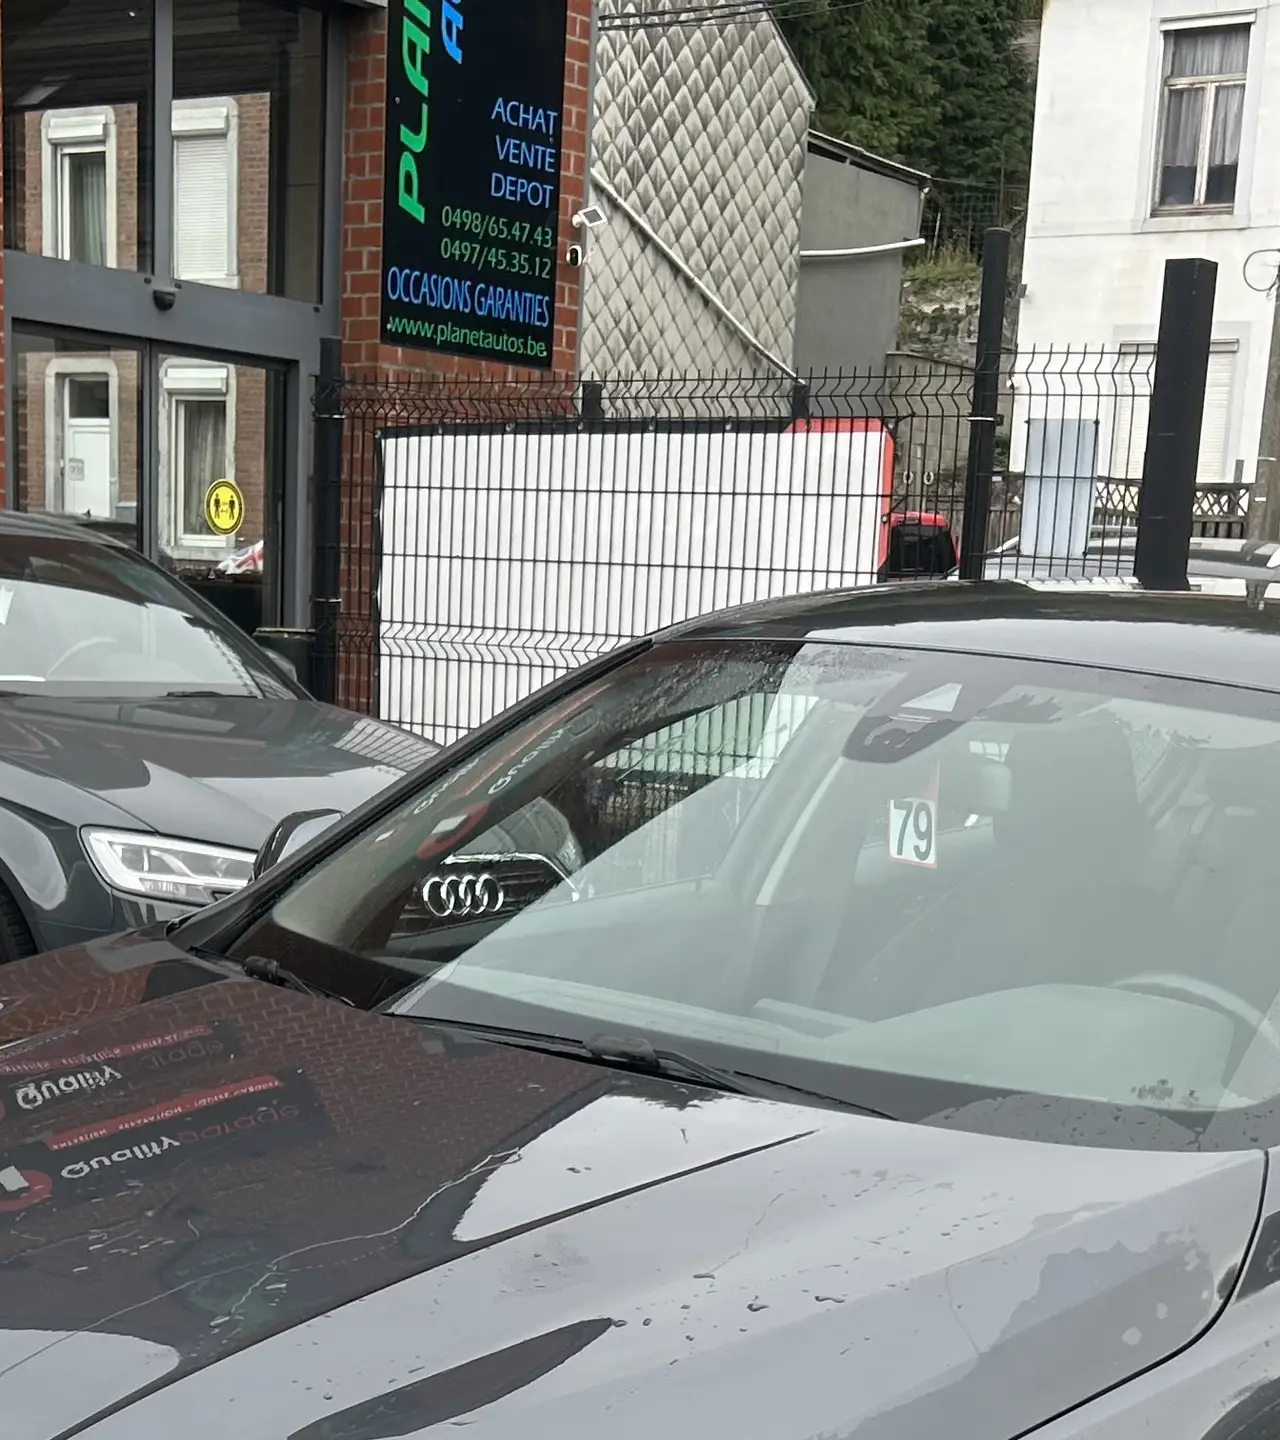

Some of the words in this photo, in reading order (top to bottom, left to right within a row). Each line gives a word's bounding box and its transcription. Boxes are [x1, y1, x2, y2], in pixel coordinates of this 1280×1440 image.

[491, 97, 558, 136] ACHAT
[495, 134, 557, 173] VENTE
[490, 171, 554, 209] DEPOT
[441, 205, 554, 249] 0498/65.47.43
[440, 237, 552, 280] 0497/45.35.12
[387, 266, 472, 314] OCCASIONS
[474, 283, 550, 328] GARANTIES
[388, 316, 548, 358] www.planetautos.be
[893, 799, 933, 862] 79
